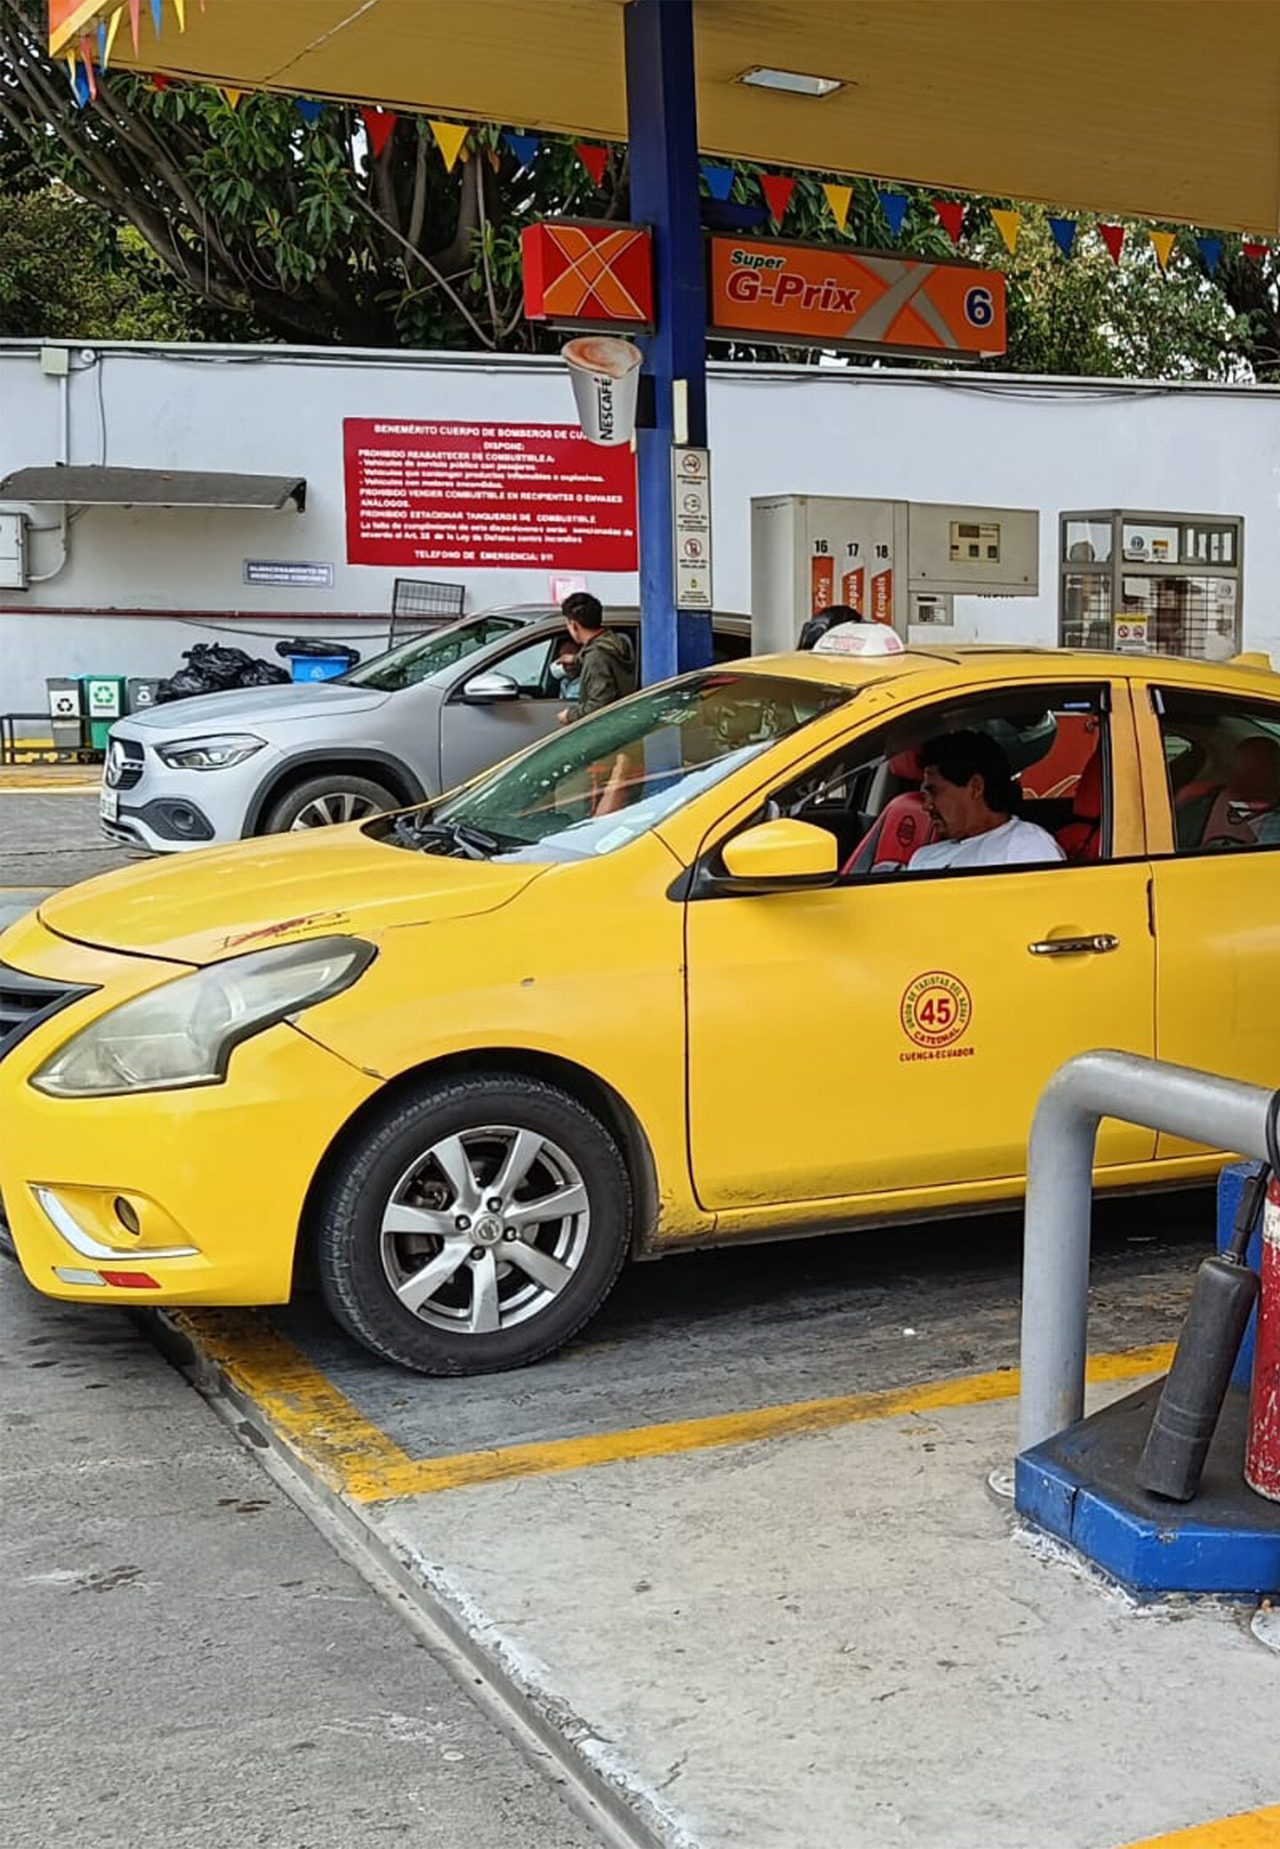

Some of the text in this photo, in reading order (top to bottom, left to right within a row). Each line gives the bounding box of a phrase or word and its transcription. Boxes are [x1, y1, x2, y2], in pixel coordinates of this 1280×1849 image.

[731, 249, 786, 270] Super
[727, 269, 860, 314] G-Prix
[964, 287, 993, 328] 6
[593, 377, 614, 440] NESCAFÉ
[374, 424, 438, 435] BENEMÉRITO
[440, 427, 480, 436] CUERPO
[482, 428, 495, 437] DE
[498, 428, 552, 439] BOMBEROS
[554, 430, 568, 439] DE
[472, 452, 483, 460] DE
[815, 540, 828, 553] 16
[848, 543, 859, 557] 17
[876, 545, 888, 558] 18
[920, 998, 951, 1025] 45
